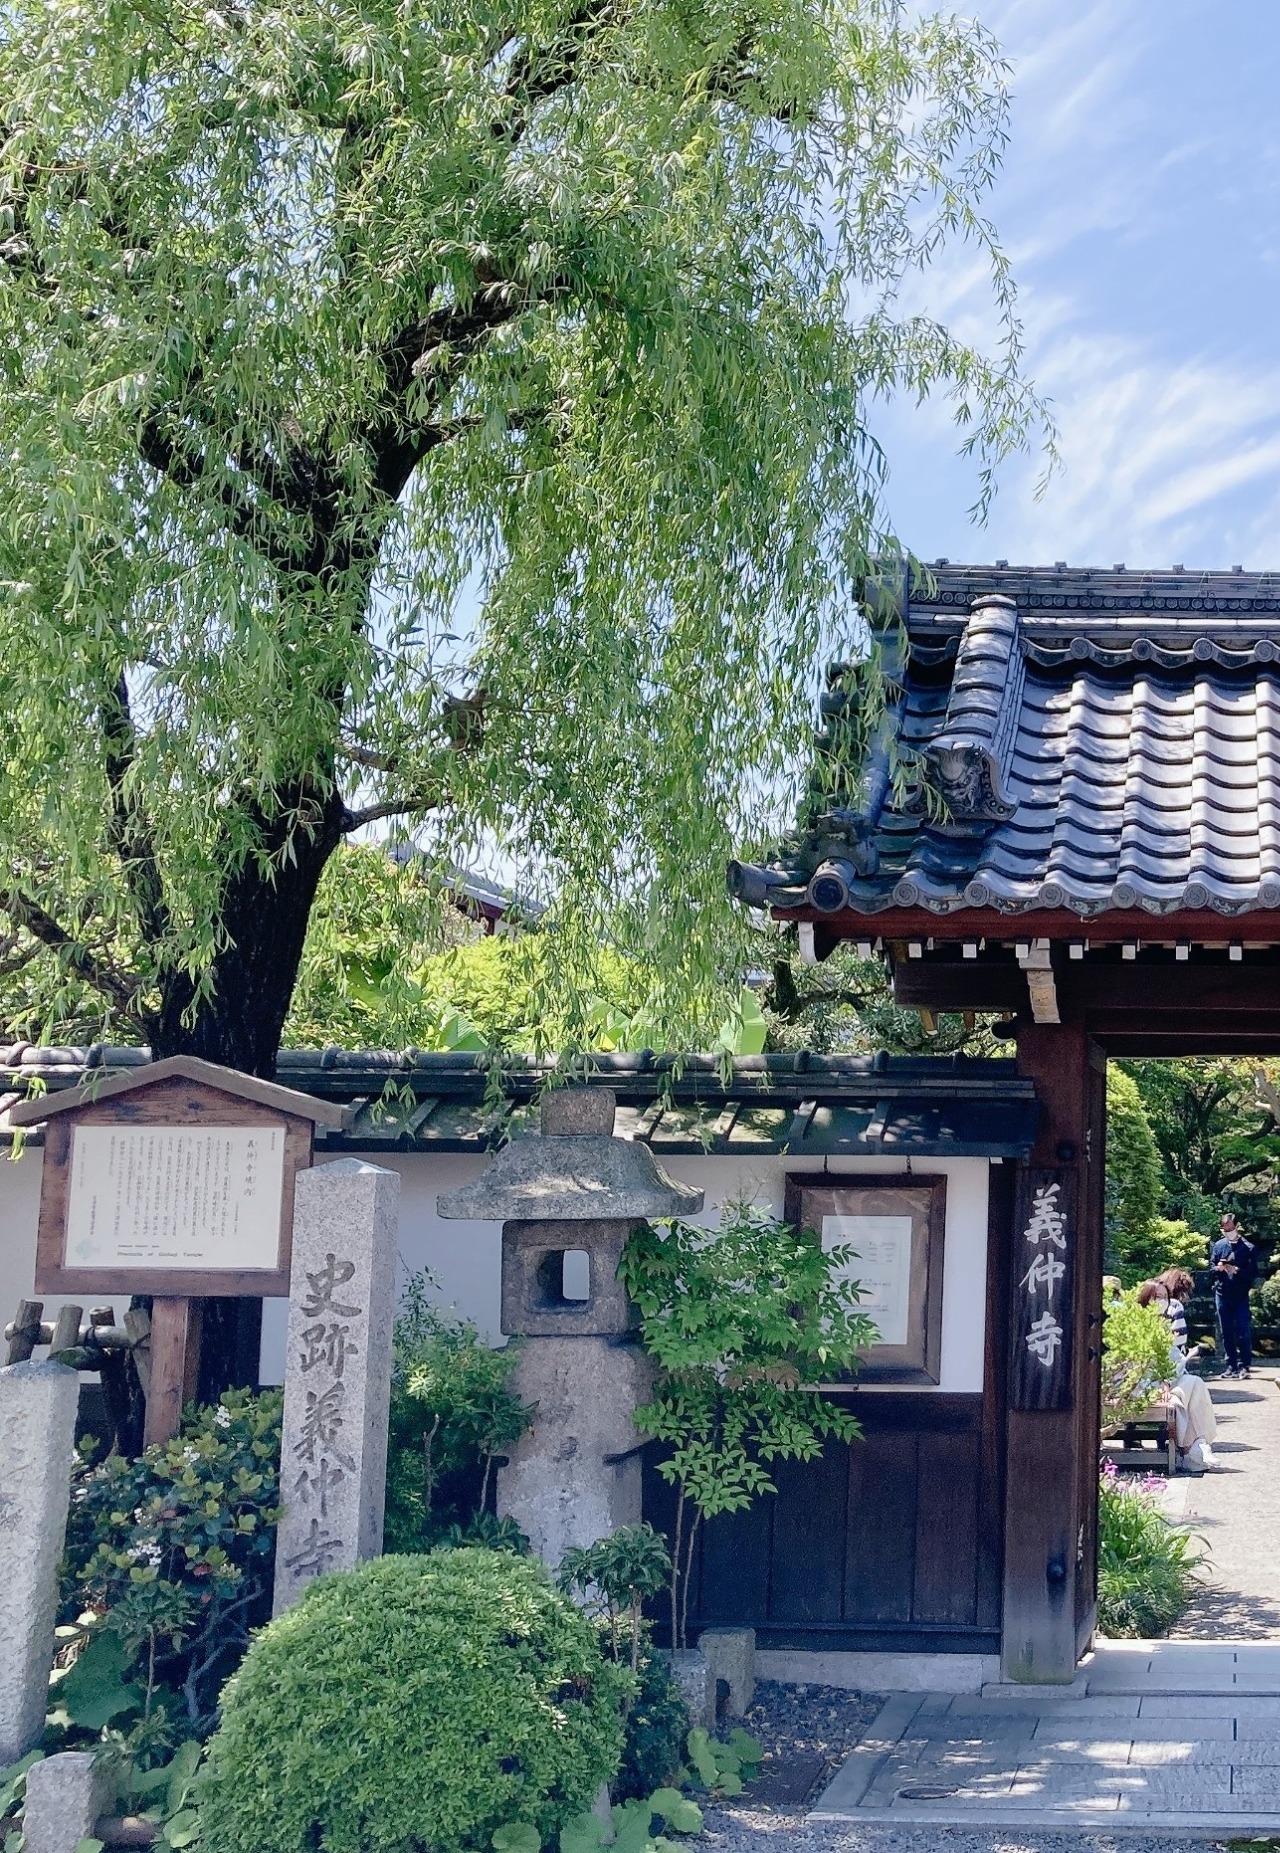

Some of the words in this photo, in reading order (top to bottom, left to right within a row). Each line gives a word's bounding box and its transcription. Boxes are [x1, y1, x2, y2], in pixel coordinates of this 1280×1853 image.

[1018, 1183, 1067, 1367] 義仲寺
[284, 1253, 363, 1578] 史跡義仲寺
